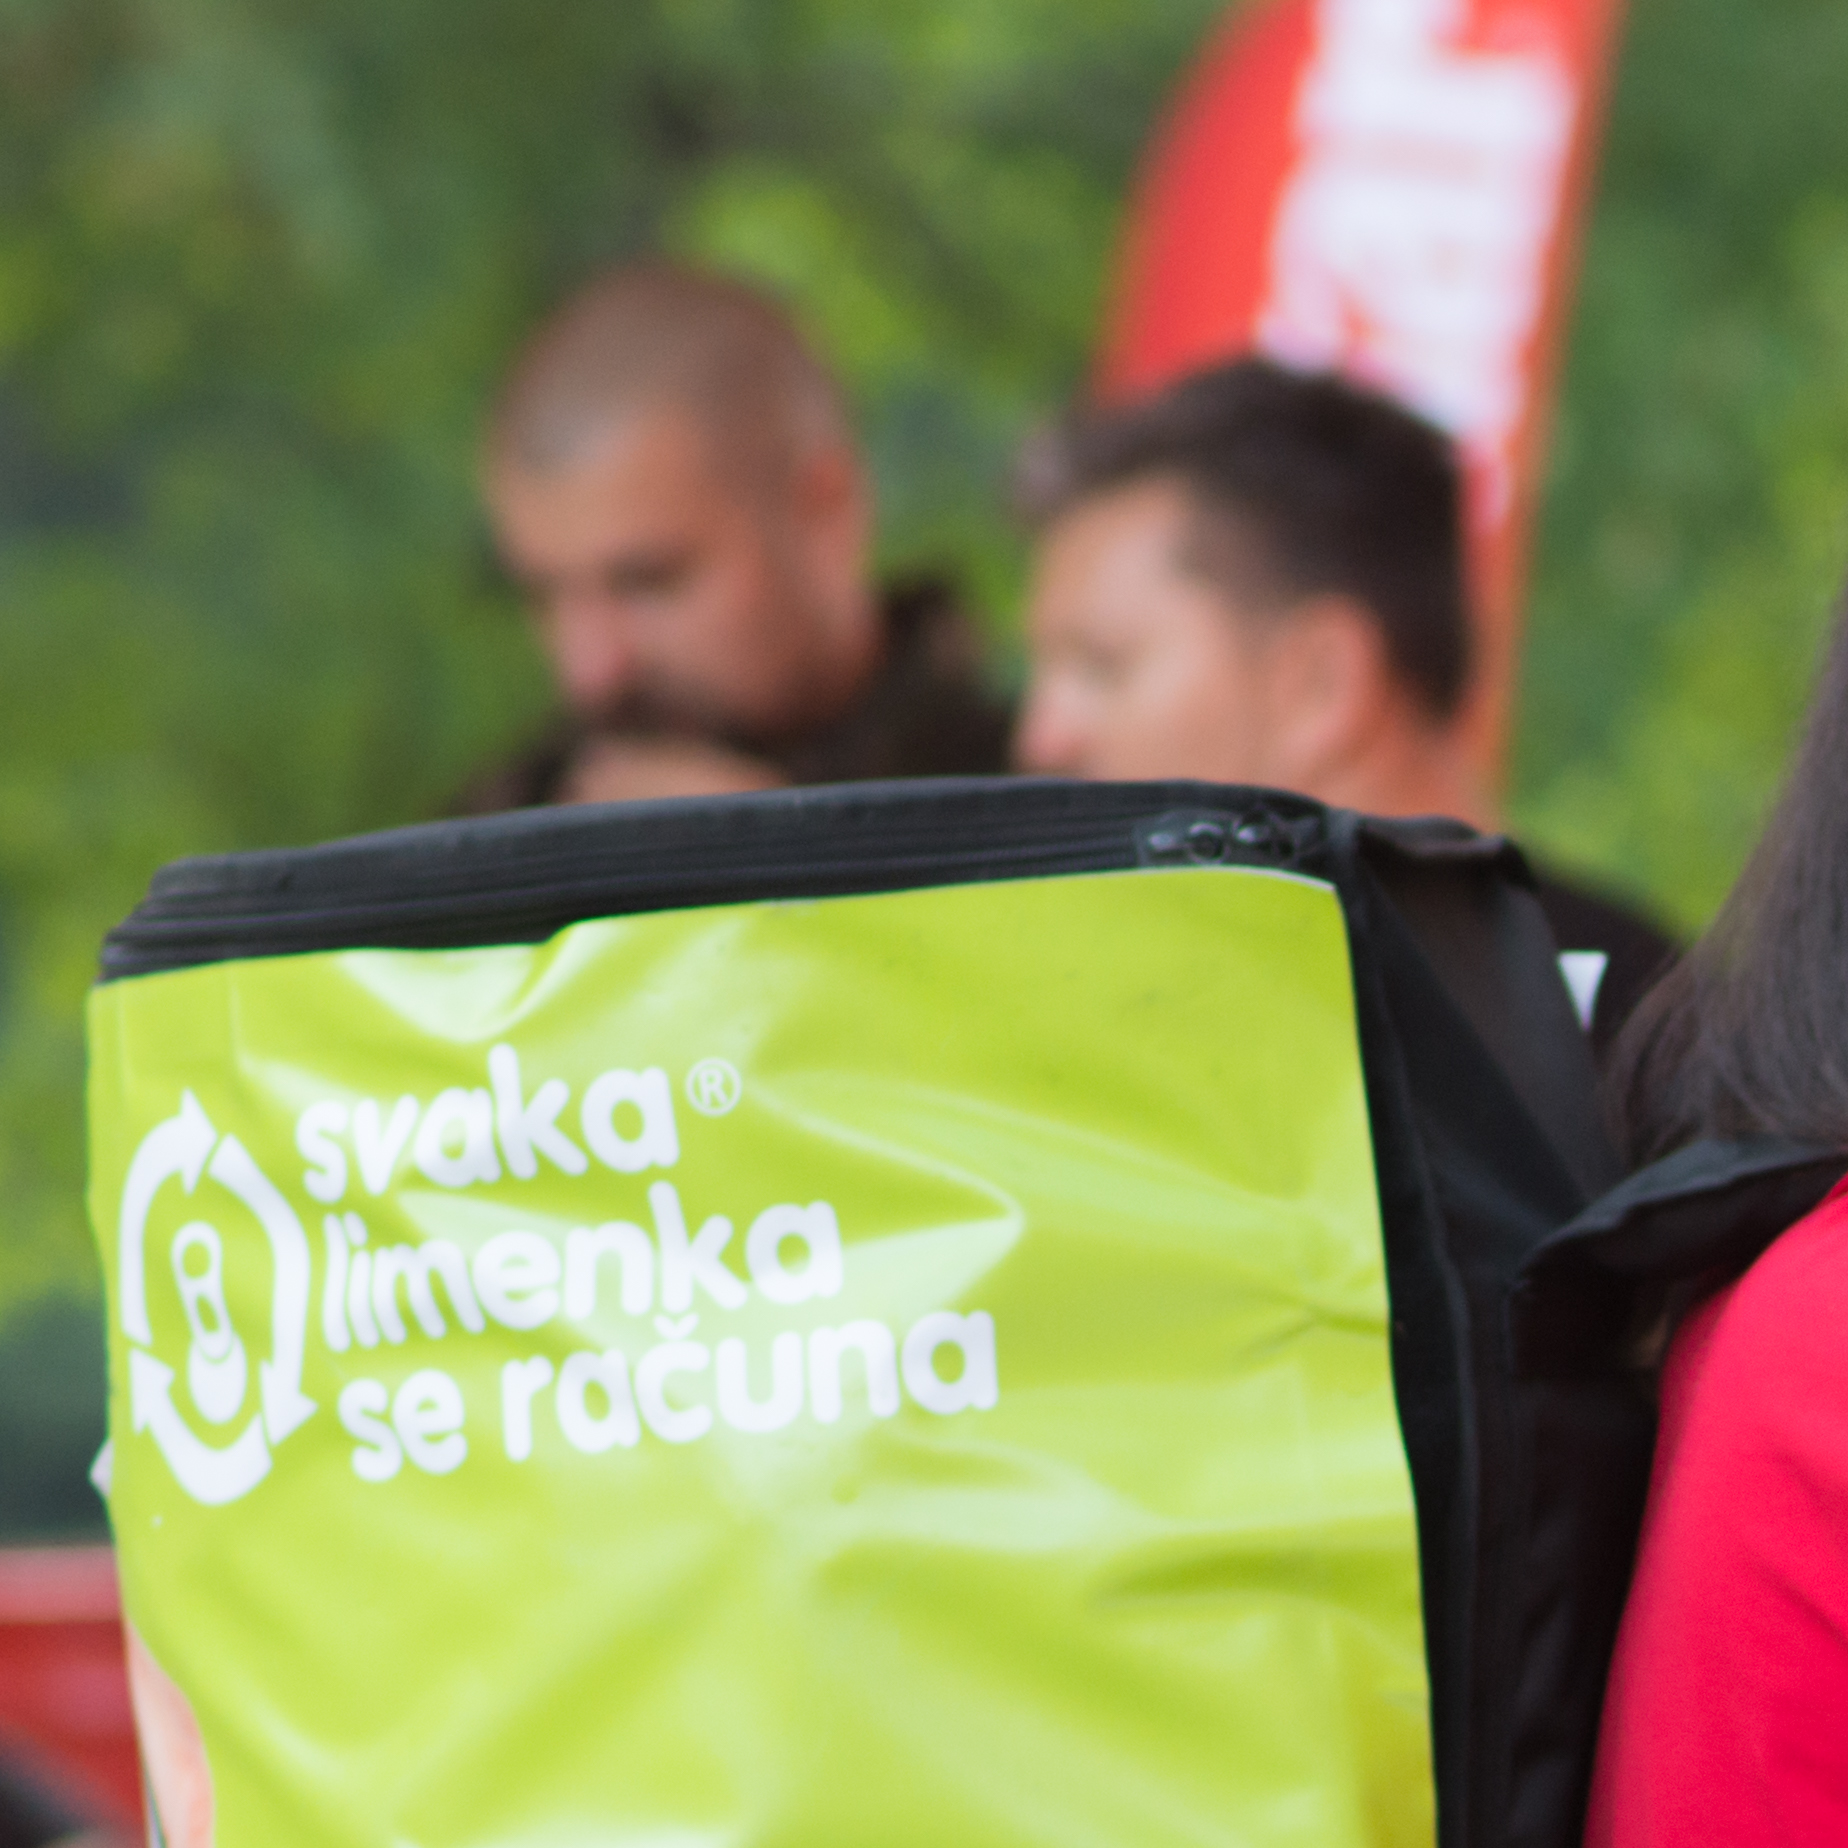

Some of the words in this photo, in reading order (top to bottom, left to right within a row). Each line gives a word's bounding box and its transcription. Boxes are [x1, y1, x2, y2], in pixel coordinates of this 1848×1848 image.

[322, 1181, 846, 1352] limenka
[336, 1364, 470, 1485] se
[500, 1310, 1000, 1461] računa
